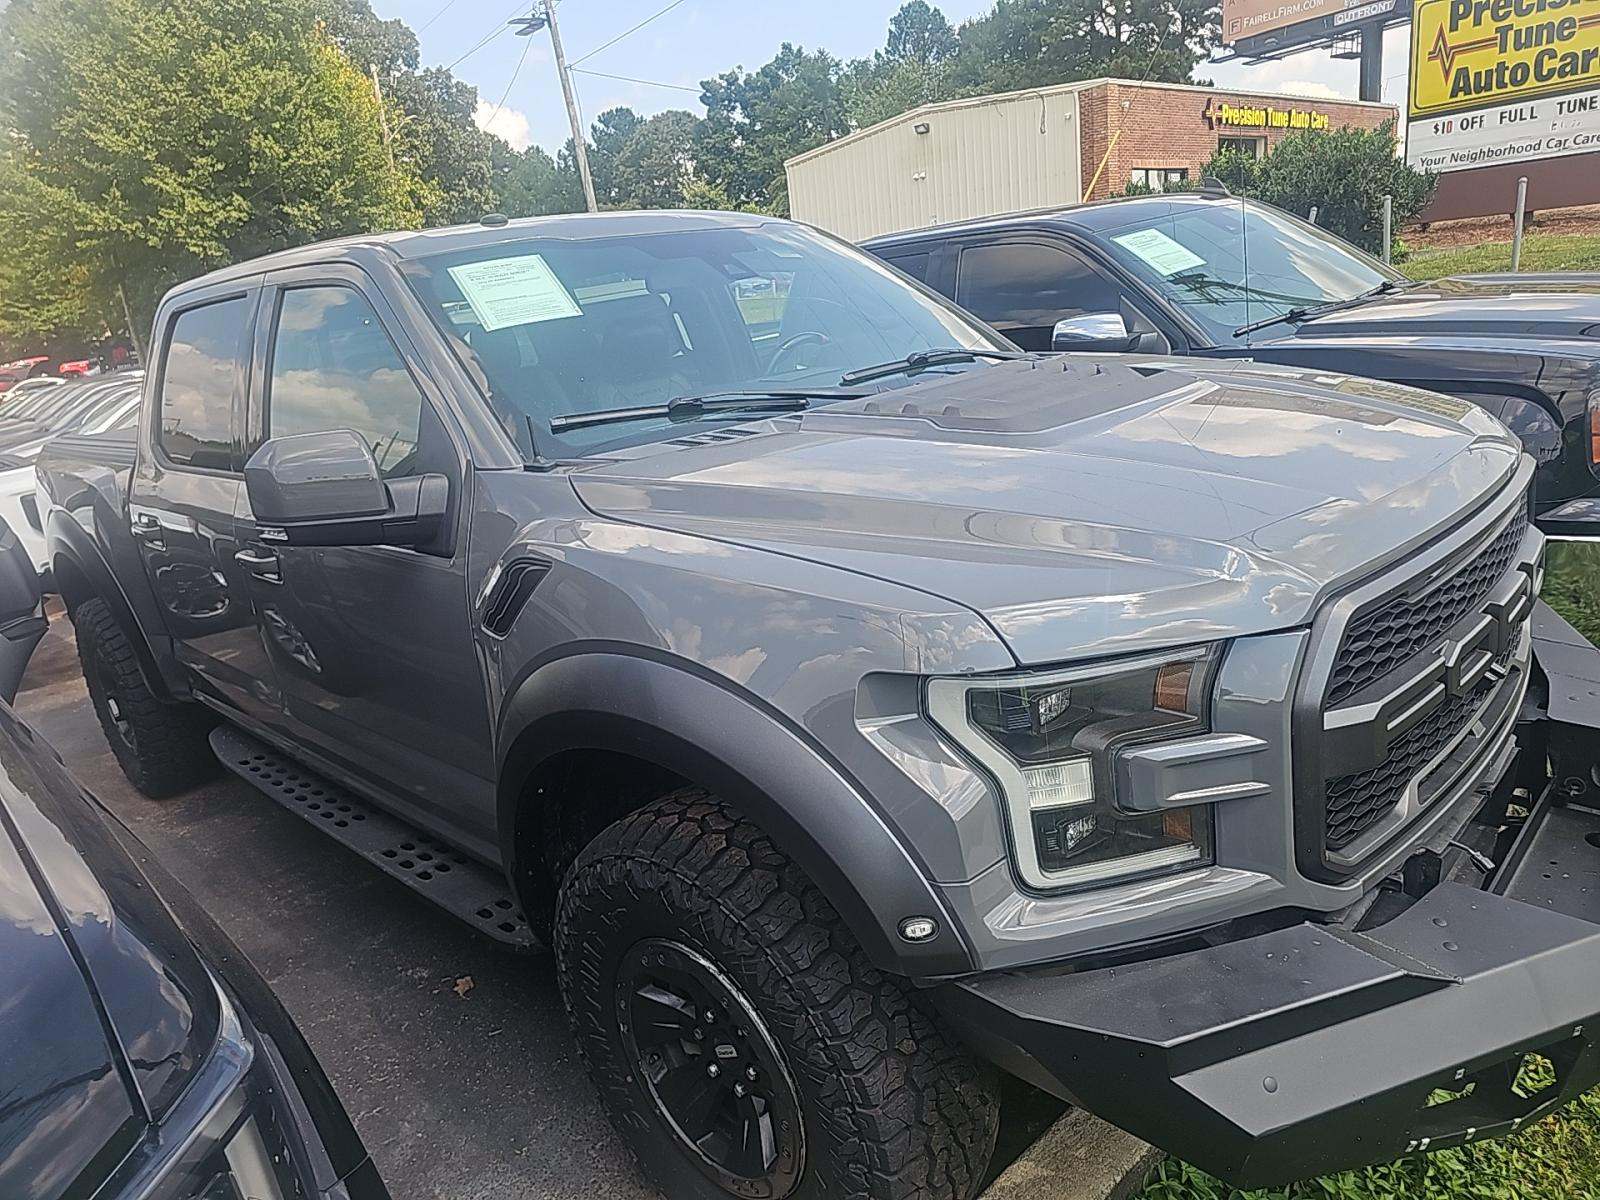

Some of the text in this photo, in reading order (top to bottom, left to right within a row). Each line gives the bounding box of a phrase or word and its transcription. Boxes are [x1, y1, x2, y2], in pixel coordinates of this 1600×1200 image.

[1336, 1, 1393, 24] OUTFRONT
[1495, 16, 1577, 54] Tune
[1449, 45, 1600, 99] Auto Car
[1221, 103, 1329, 129] Precision Tune Auto Care
[1433, 95, 1599, 135] $10 OFF FULL TUNE
[1419, 132, 1600, 168] Your Neighborhood Car Care
